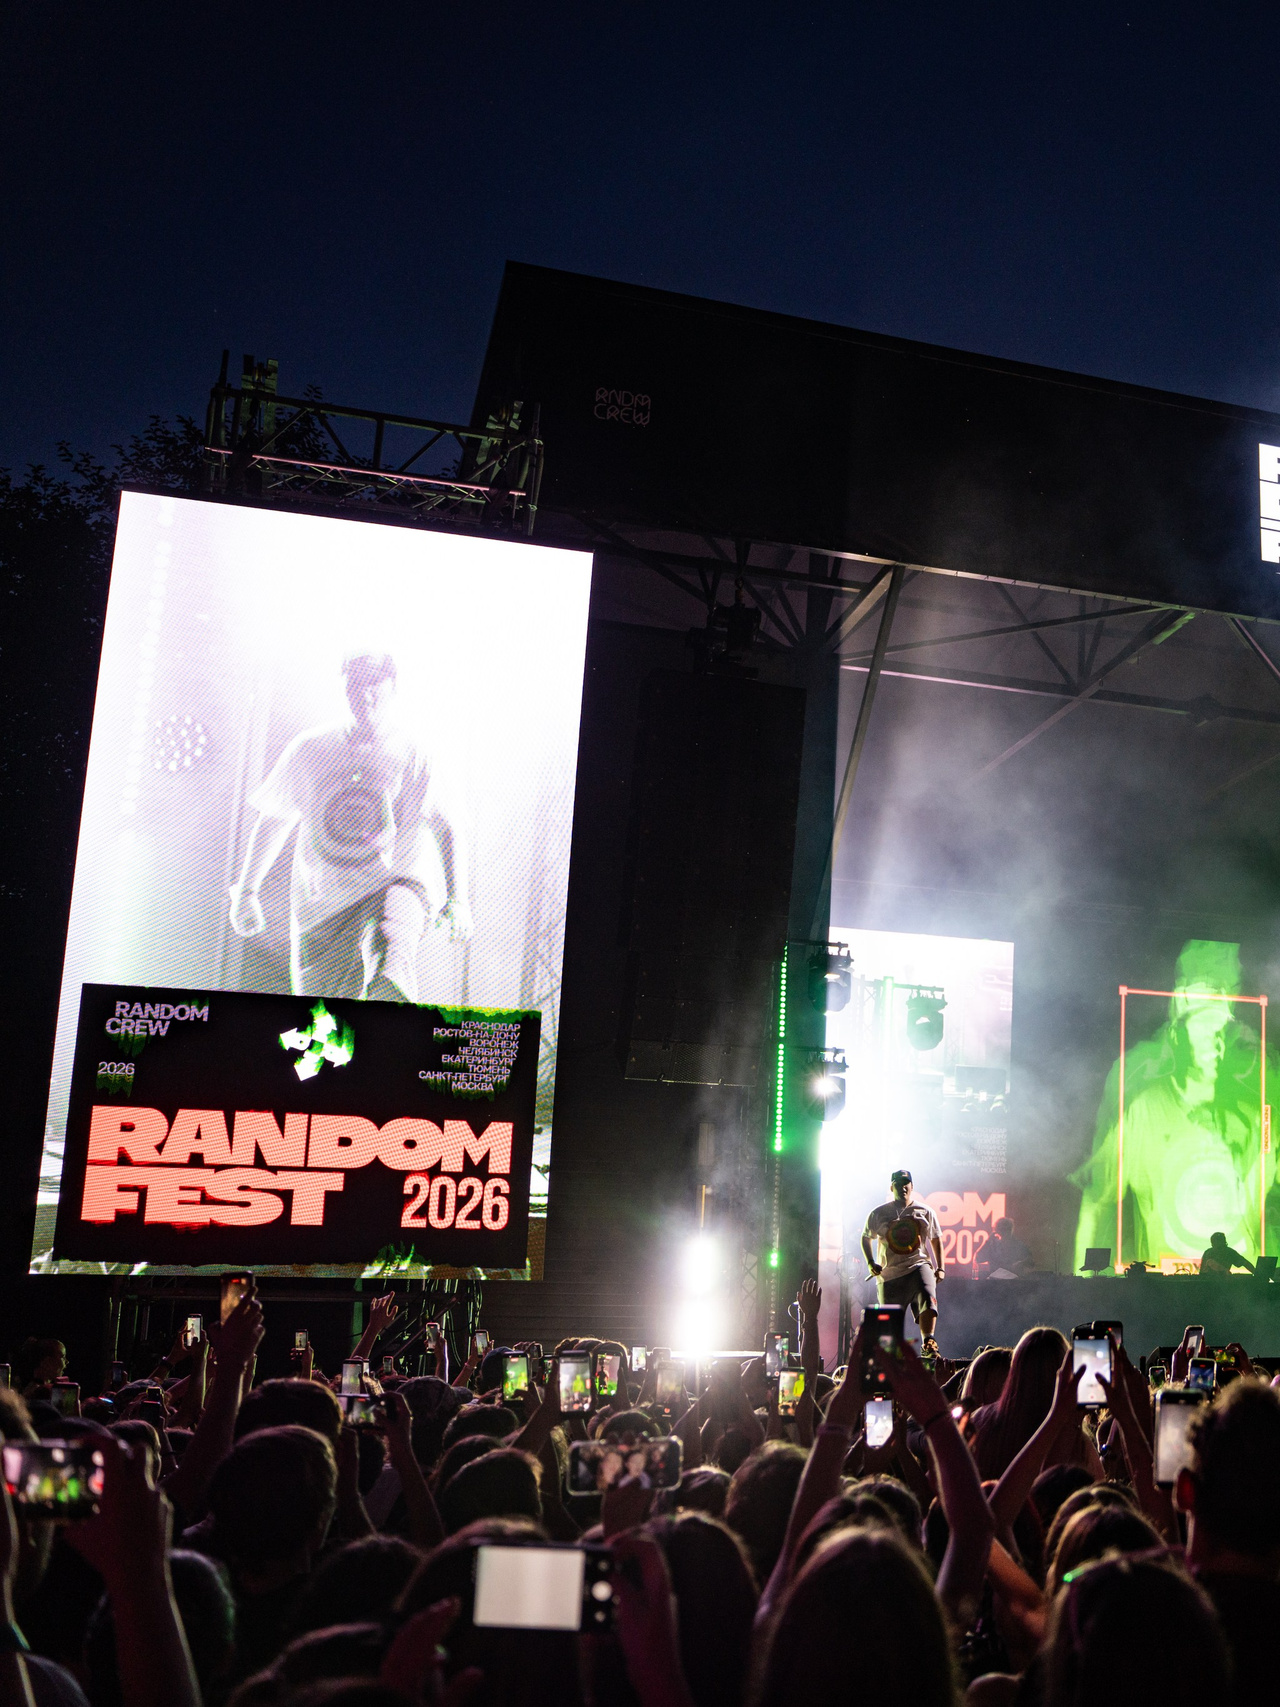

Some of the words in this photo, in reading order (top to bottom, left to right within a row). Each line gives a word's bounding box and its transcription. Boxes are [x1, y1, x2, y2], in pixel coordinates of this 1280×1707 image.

[594, 403, 651, 426] CREW
[115, 1000, 209, 1022] RANDOM
[105, 1017, 171, 1036] CREW
[461, 1020, 521, 1032] КРАСНОДАР
[433, 1027, 520, 1040] РОСТОВ-НА-ДОНУ
[469, 1038, 519, 1049] ВОРОНЕЖ
[458, 1046, 518, 1058] ЧЕЛЯБИНСК
[441, 1054, 516, 1066] ЕКАТЕРИНБУРГ
[97, 1061, 136, 1075] 2026
[468, 1064, 511, 1075] ТЮМЕНЬ
[418, 1070, 510, 1083] САНКТ-ПЕТЕРБУРГ
[451, 1081, 494, 1091] МОСКВА
[86, 1105, 514, 1174] RANDOM
[80, 1165, 344, 1226] FEST
[400, 1177, 509, 1230] 2026
[942, 1230, 990, 1265] 202
